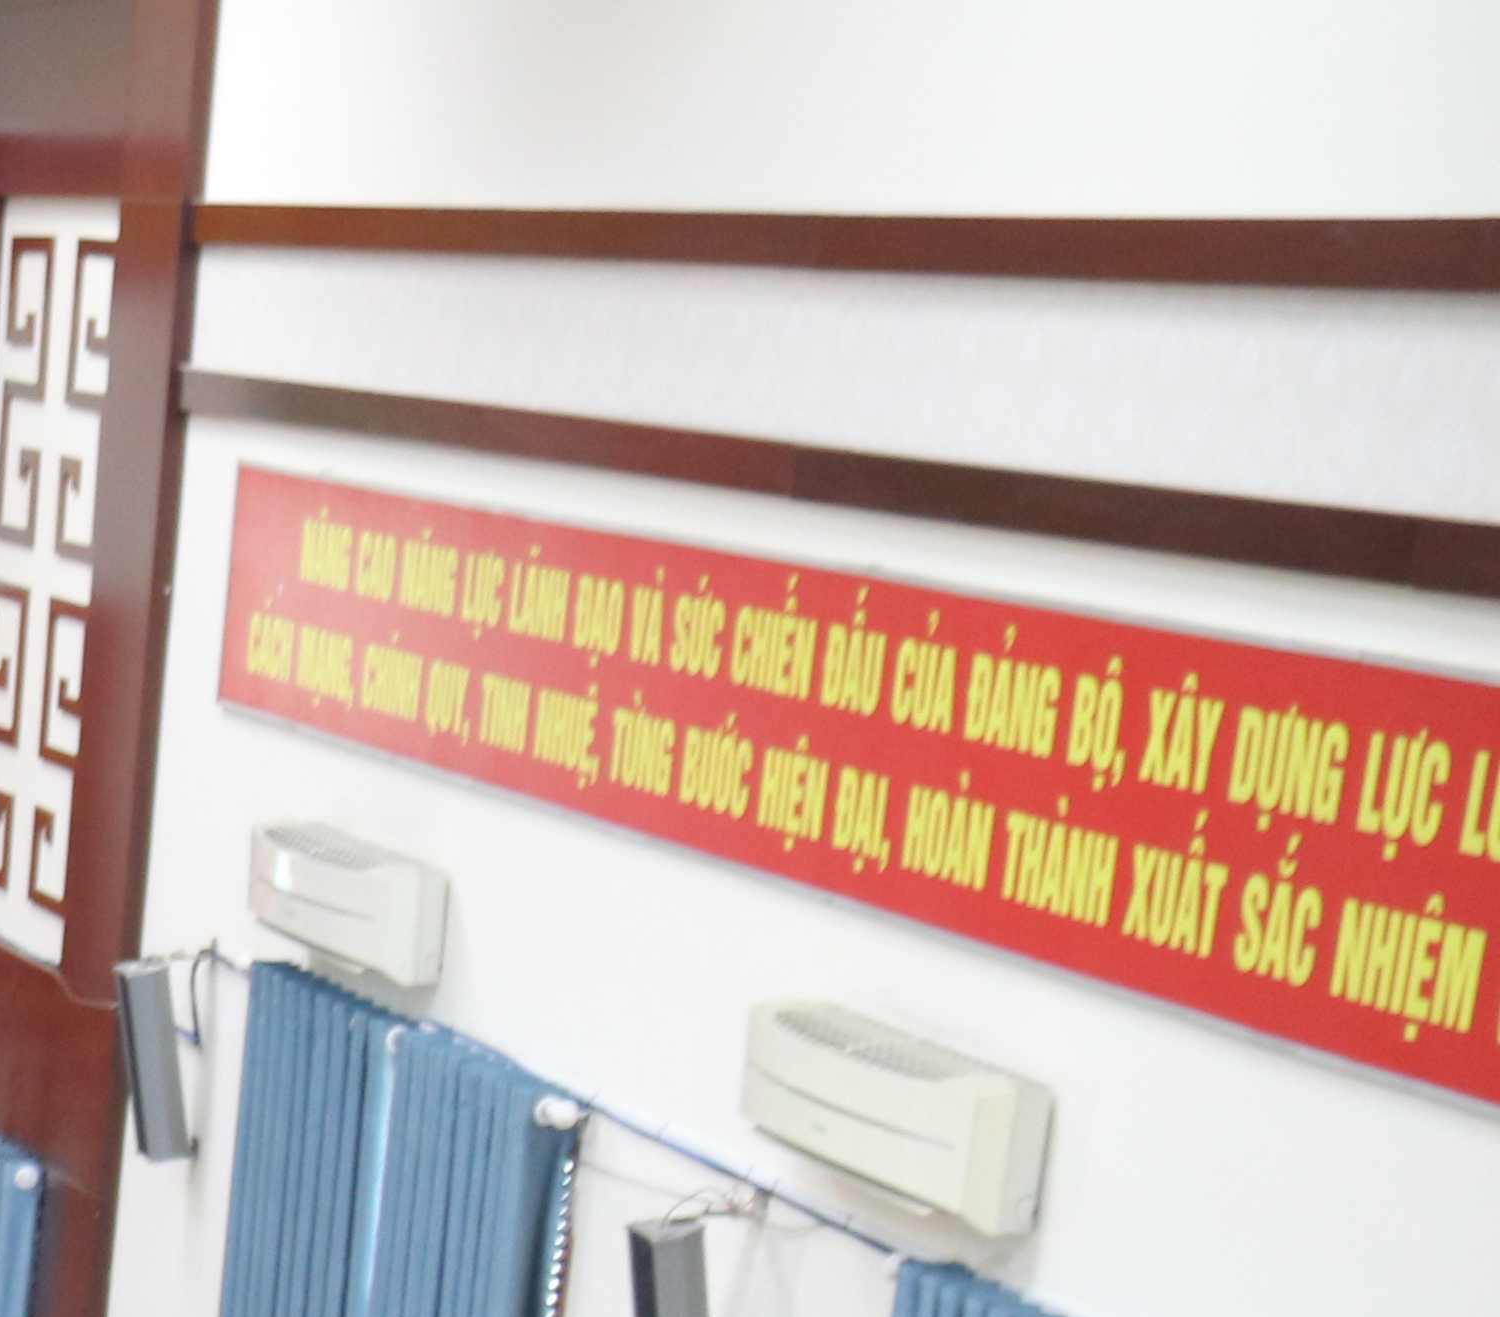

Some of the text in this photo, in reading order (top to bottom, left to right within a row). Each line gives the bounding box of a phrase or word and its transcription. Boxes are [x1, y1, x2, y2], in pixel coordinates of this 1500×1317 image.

[246, 598, 294, 683] CÁCH
[361, 630, 423, 722] CHÍNH
[426, 659, 472, 747] QUY,
[479, 672, 532, 753] TINH
[533, 682, 599, 790] NHUỆ,
[610, 689, 675, 797] TỪNG
[678, 711, 754, 820] BƯỚC
[756, 734, 829, 853] HIỆN
[831, 764, 892, 875] ĐẠI,
[901, 769, 995, 891] HOÀN
[1002, 795, 1119, 928] THÀNH
[1121, 808, 1229, 959] XUẤT
[1233, 831, 1323, 987] SẮC
[1329, 892, 1487, 1043] NHIỆM
[299, 507, 352, 592] NÂNG
[355, 530, 396, 602] CAO
[400, 529, 458, 618] NĂNG
[461, 550, 504, 639] LỰC
[509, 545, 570, 642] LÃNH
[573, 573, 625, 667] ĐẠO
[630, 567, 665, 665] VÀ
[670, 575, 726, 678] SỨC
[730, 575, 818, 699] CHIẾN
[820, 585, 886, 717] ĐẤU
[891, 609, 956, 734] CỦA
[964, 625, 1061, 759] ĐẢNG
[1066, 655, 1126, 791] BỘ,
[1139, 672, 1224, 794] XÂY
[1227, 704, 1349, 831] DỰNG
[1356, 727, 1451, 861] LỰC
